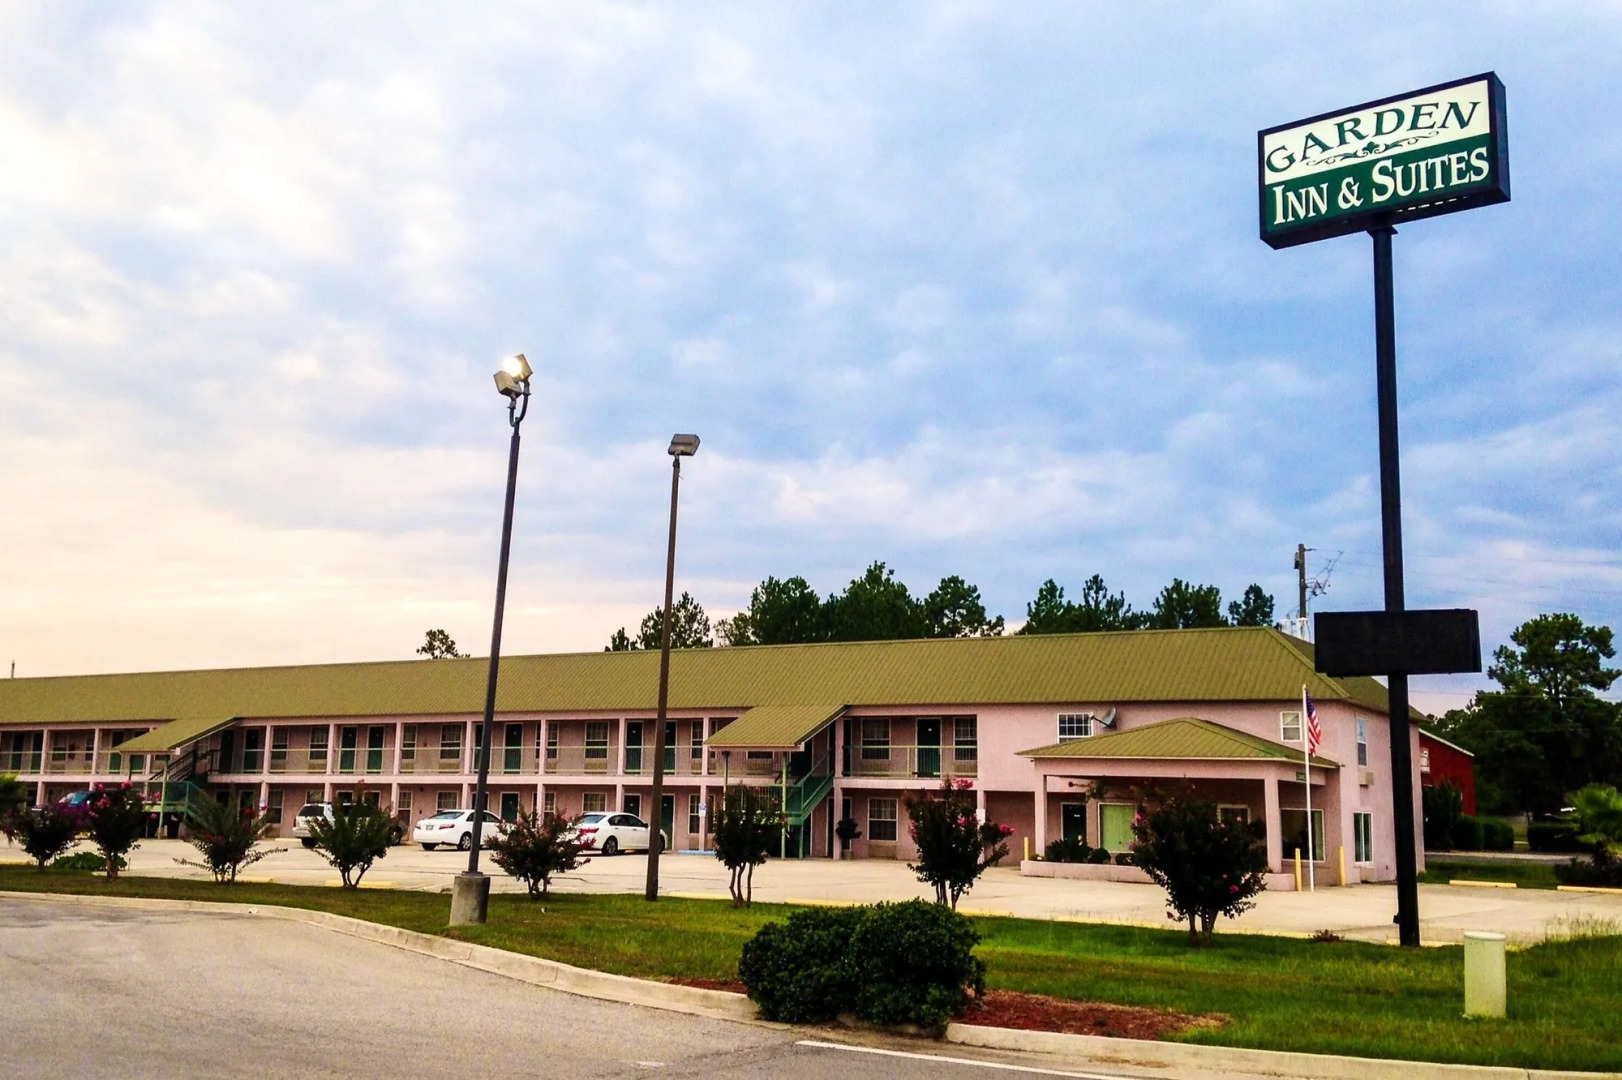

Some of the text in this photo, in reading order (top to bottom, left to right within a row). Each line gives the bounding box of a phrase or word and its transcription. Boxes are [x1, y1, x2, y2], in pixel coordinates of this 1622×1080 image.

[1265, 101, 1480, 173] GARDEN
[1272, 146, 1490, 226] INN & SUITES
